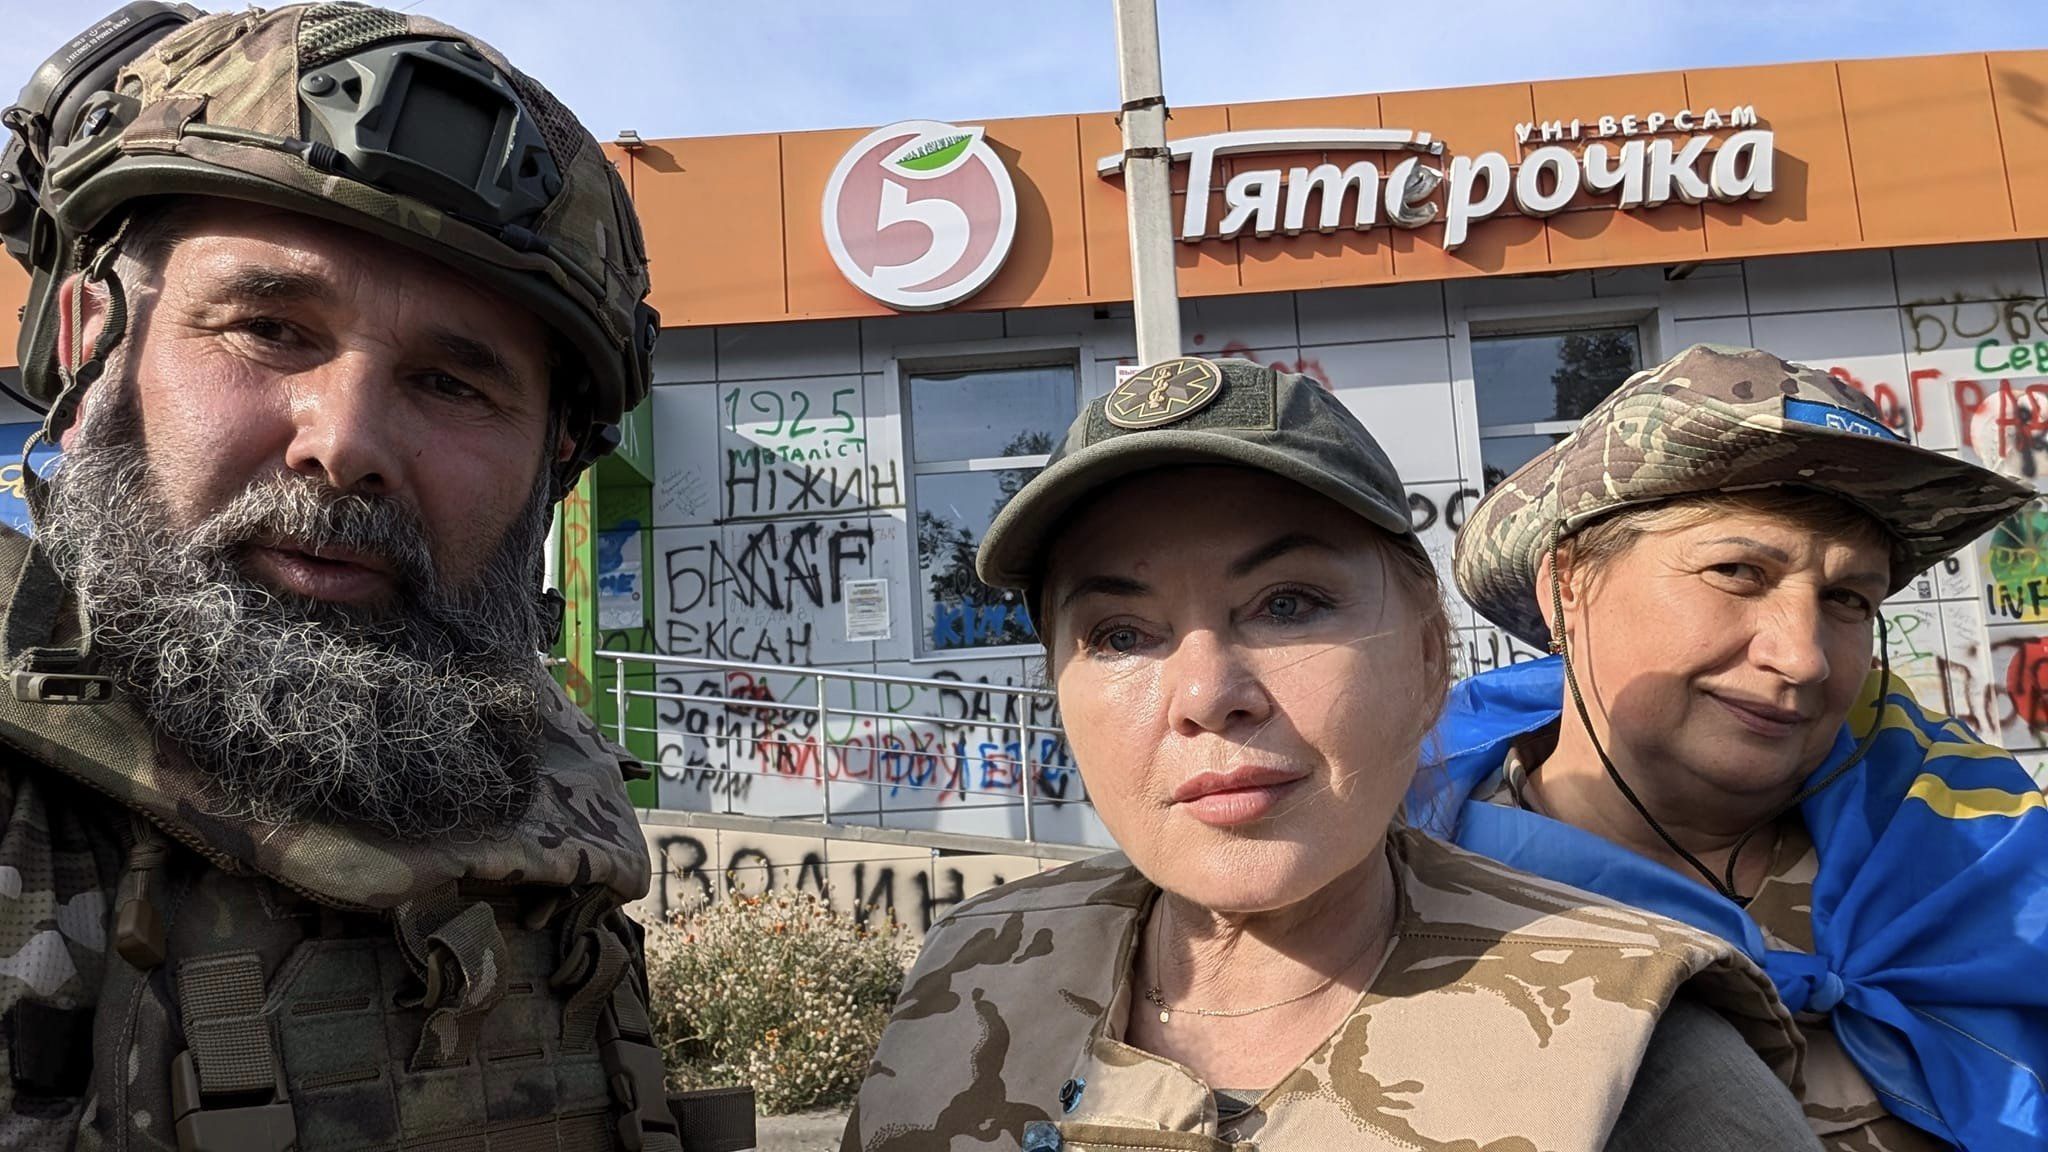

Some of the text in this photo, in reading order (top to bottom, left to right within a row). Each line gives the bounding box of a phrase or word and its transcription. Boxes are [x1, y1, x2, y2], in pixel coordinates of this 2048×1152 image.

[724, 387, 856, 439] 1925
[725, 446, 901, 517] НІЖИН
[658, 835, 1004, 932] ВОЛИН
